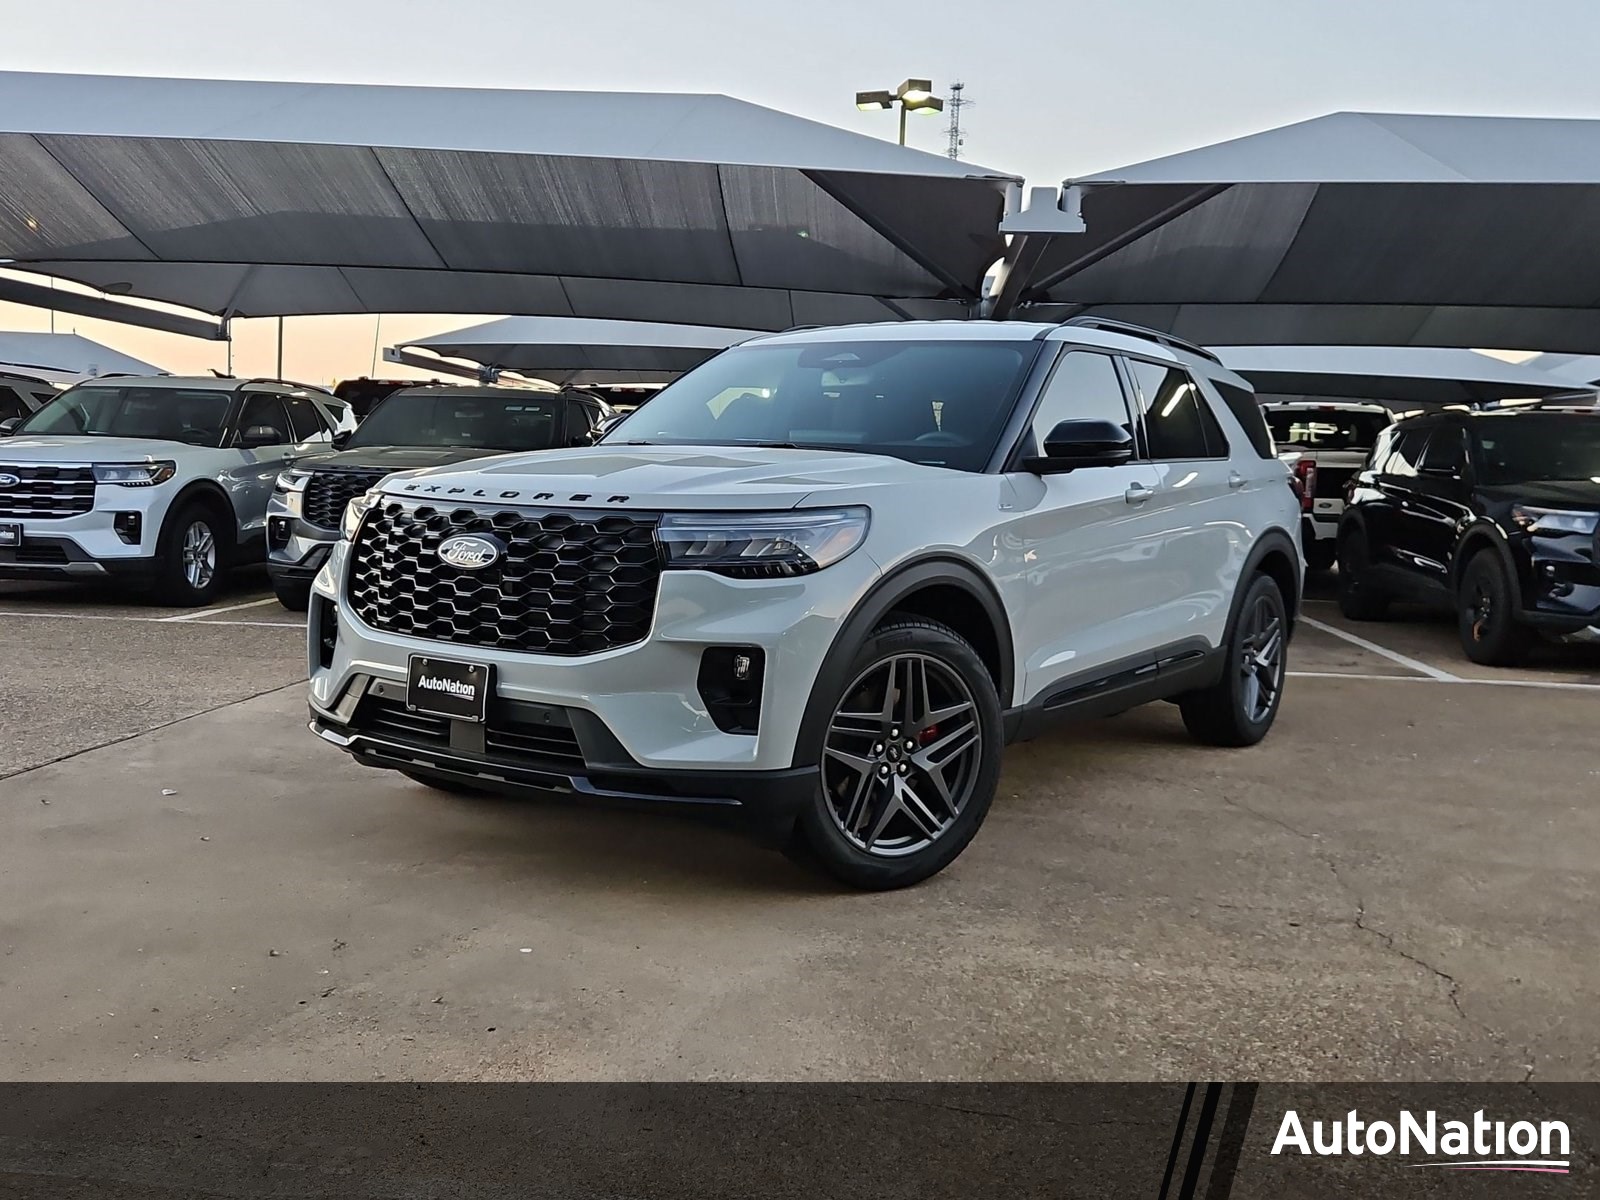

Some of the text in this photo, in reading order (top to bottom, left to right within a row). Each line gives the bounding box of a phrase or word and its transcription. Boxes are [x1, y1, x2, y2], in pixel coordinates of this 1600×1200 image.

[404, 484, 630, 503] EXPLORER
[446, 540, 489, 563] Ford
[417, 674, 475, 696] AutoNation
